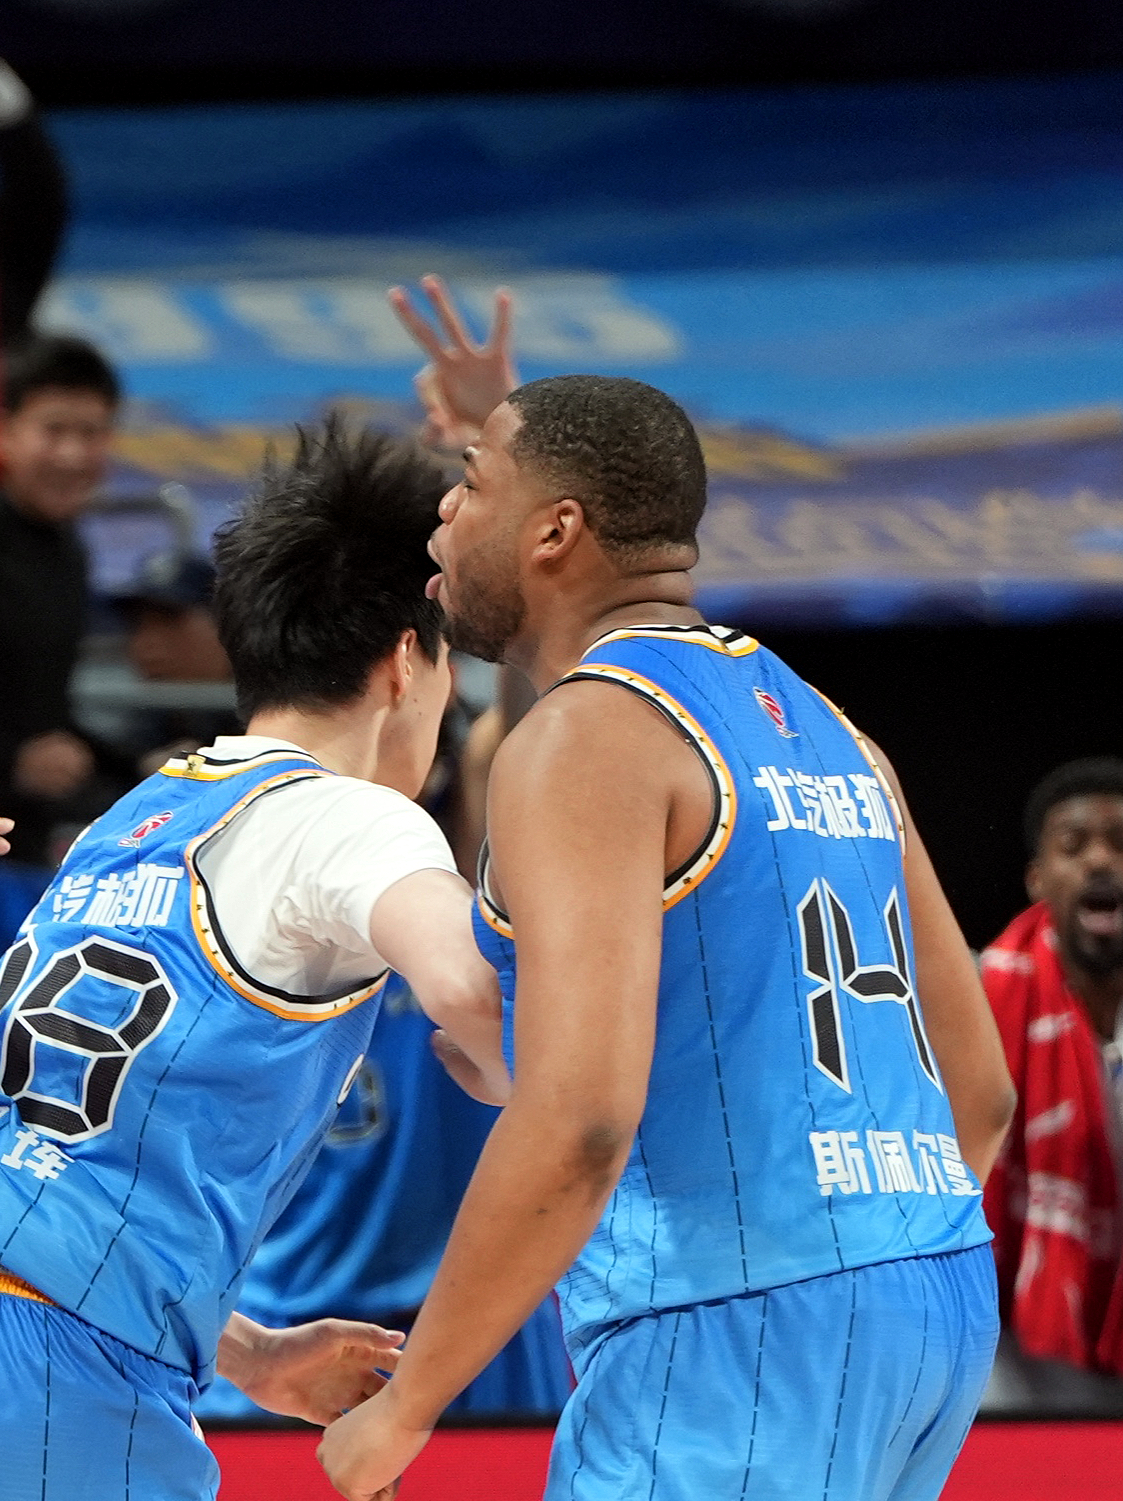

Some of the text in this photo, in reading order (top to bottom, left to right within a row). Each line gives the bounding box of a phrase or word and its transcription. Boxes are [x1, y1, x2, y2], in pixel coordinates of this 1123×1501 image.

[752, 765, 896, 843] 北汽极狐
[19, 863, 185, 928] 汽极狐
[796, 876, 945, 1096] 14
[808, 1128, 984, 1196] 斯佩尔曼
